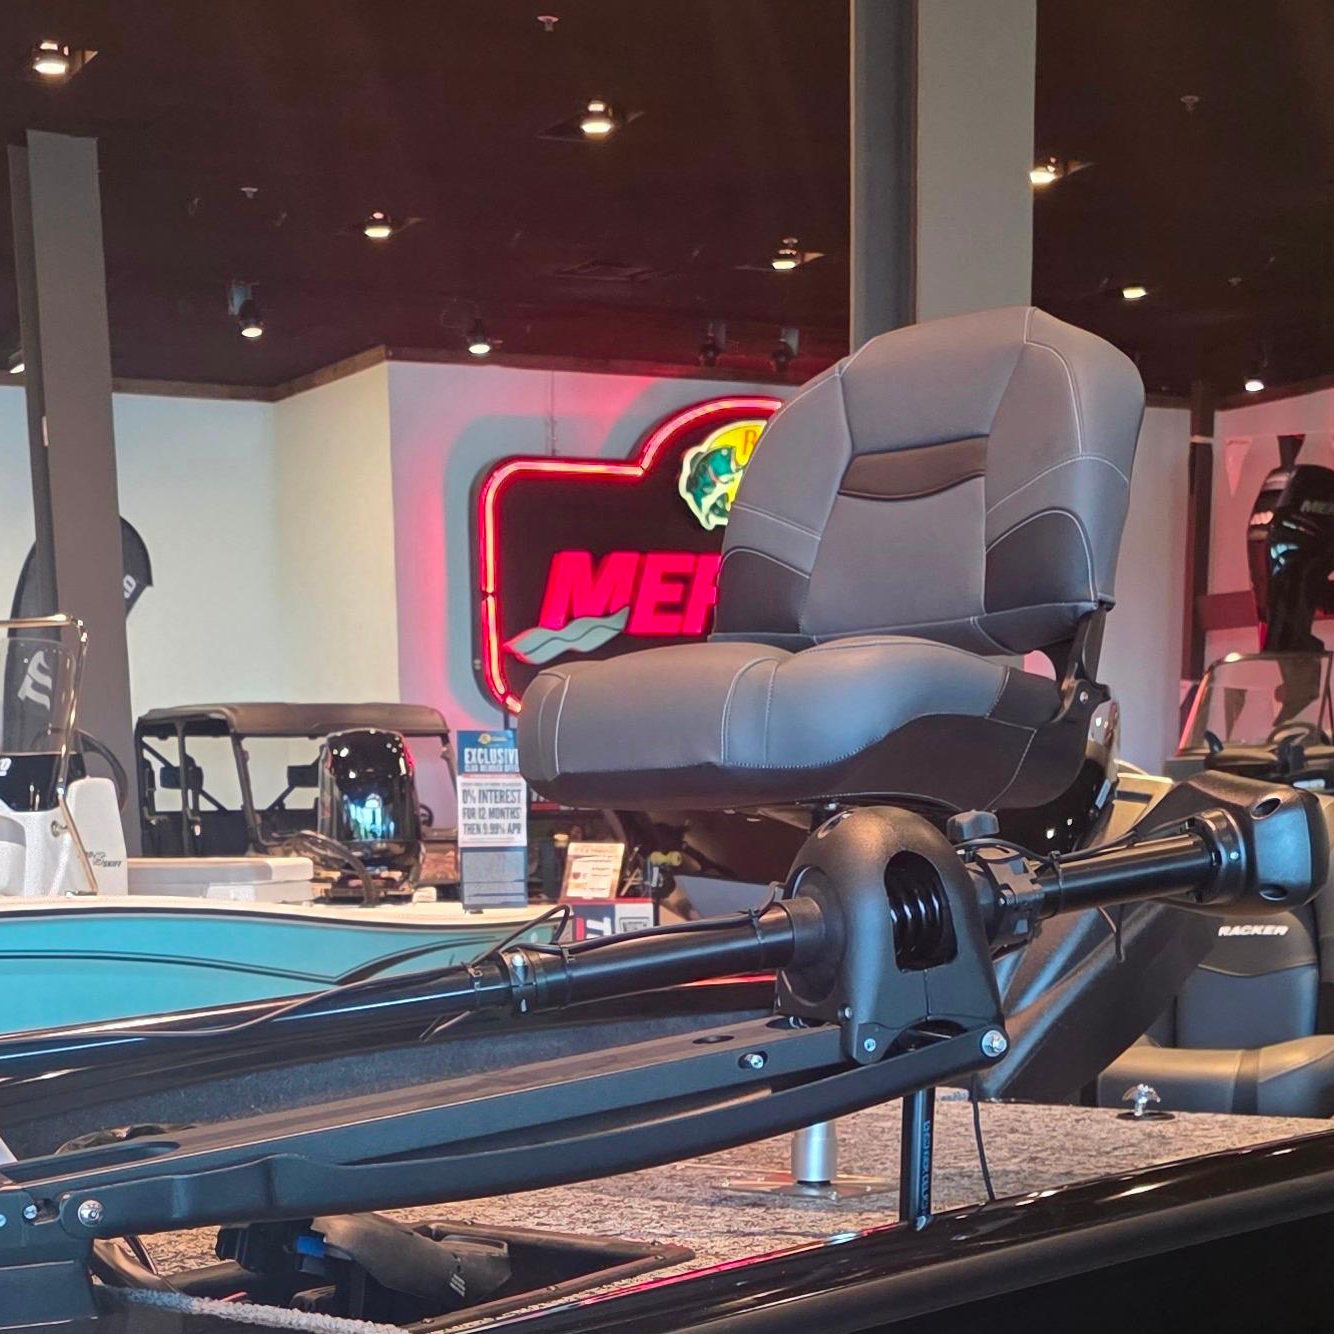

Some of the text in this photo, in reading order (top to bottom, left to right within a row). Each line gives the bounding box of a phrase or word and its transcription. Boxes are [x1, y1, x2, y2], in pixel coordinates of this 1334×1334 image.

[478, 789, 522, 804] INTEREST
[463, 807, 476, 820] FOR
[478, 807, 486, 820] 12
[463, 823, 481, 836] THEN
[507, 822, 522, 835] APR
